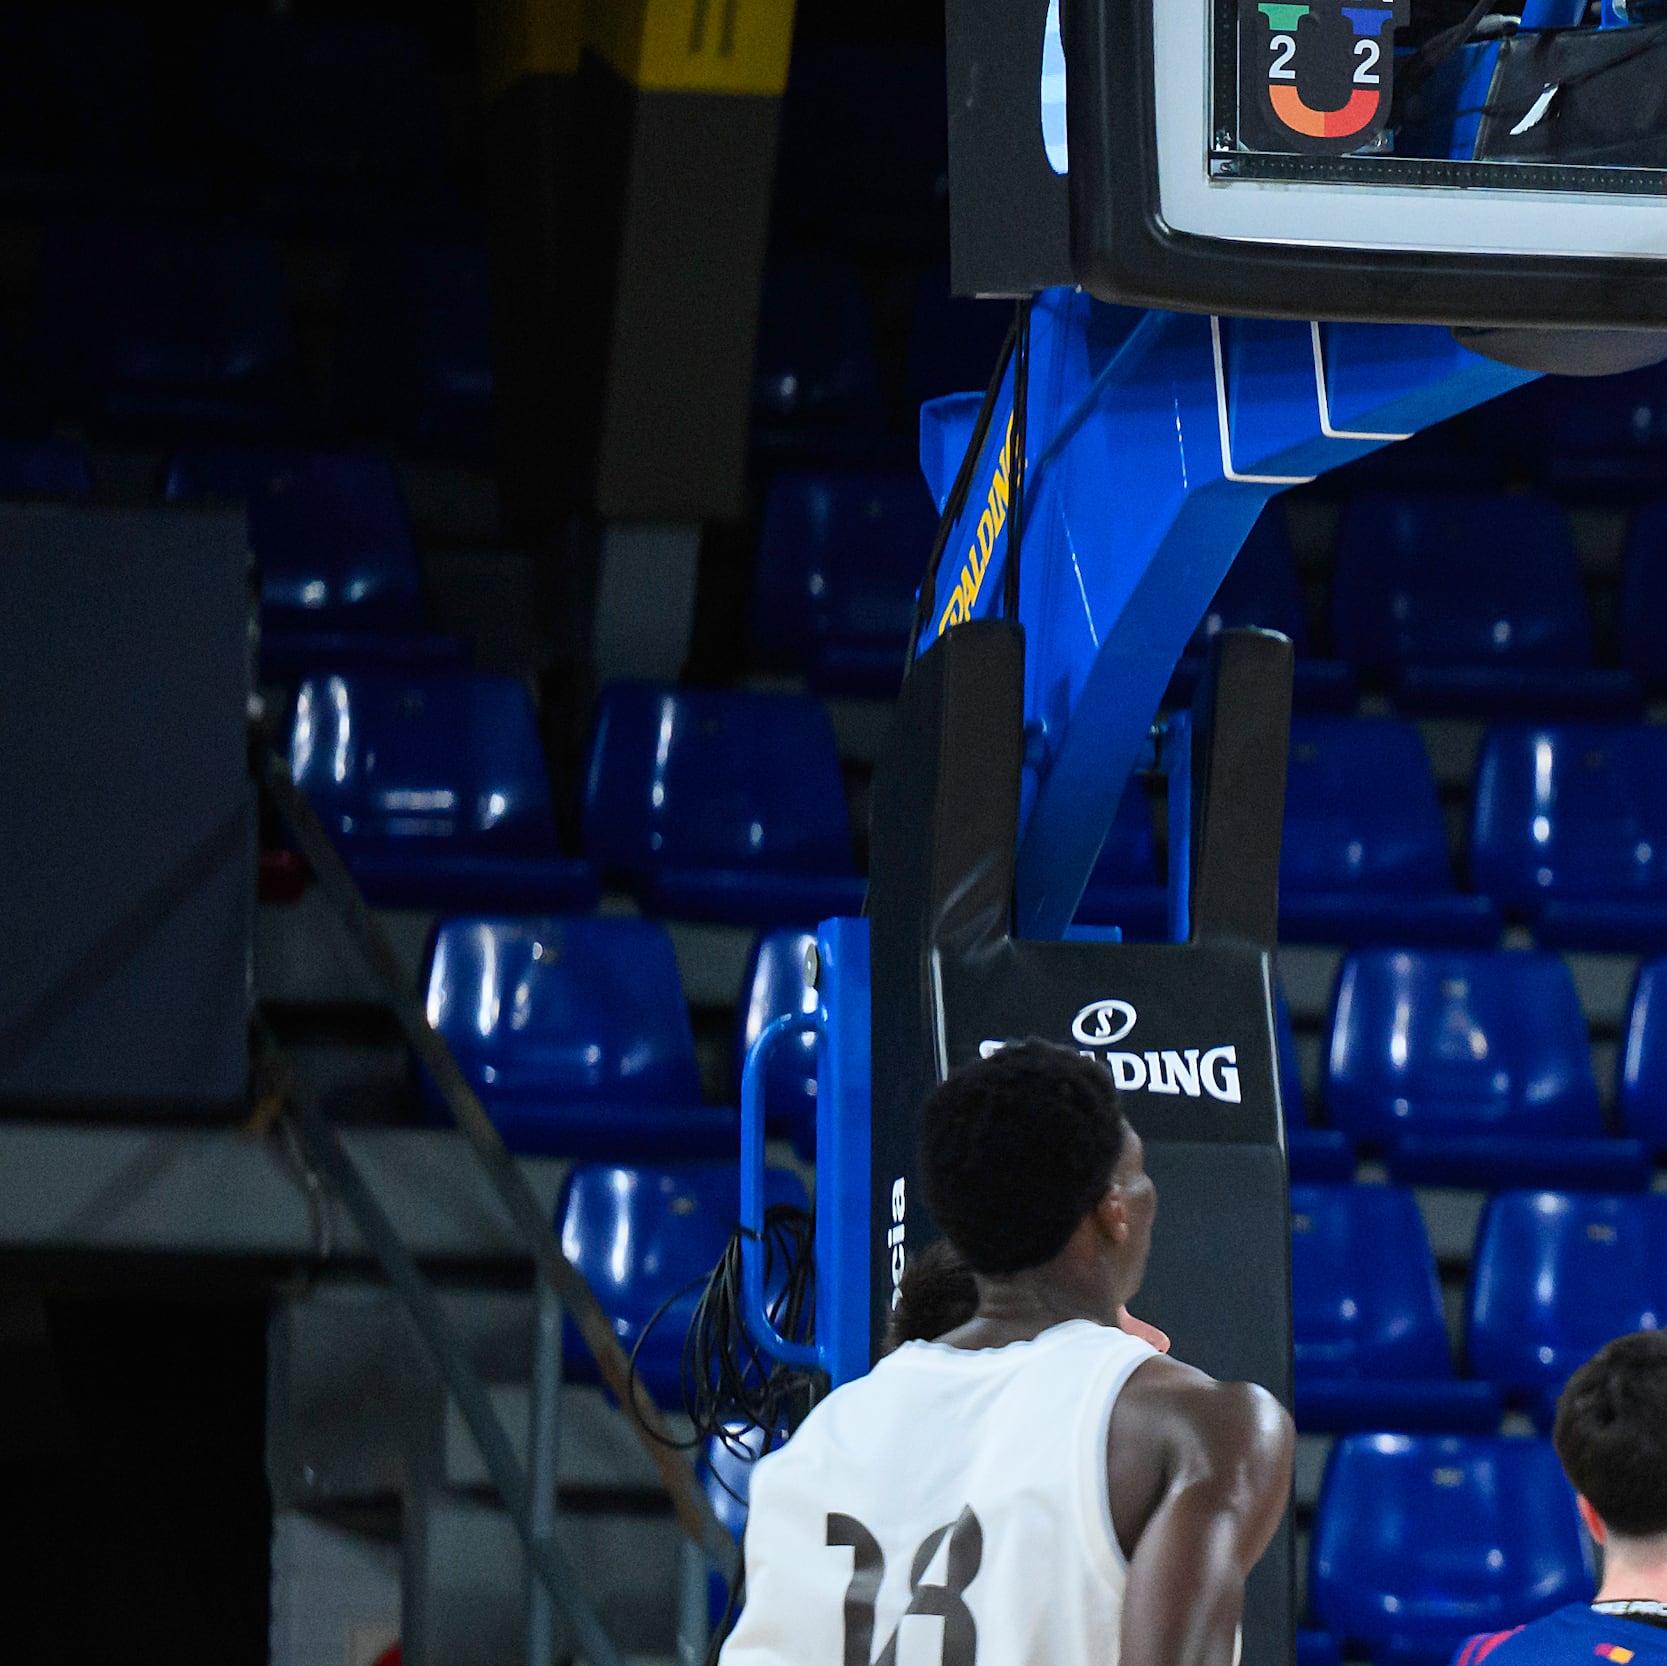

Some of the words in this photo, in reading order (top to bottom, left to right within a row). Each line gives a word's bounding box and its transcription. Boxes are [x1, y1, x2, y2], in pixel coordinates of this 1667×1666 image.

[1268, 34, 1297, 80] 2
[1352, 38, 1381, 84] 2
[938, 409, 1014, 636] PALDIN
